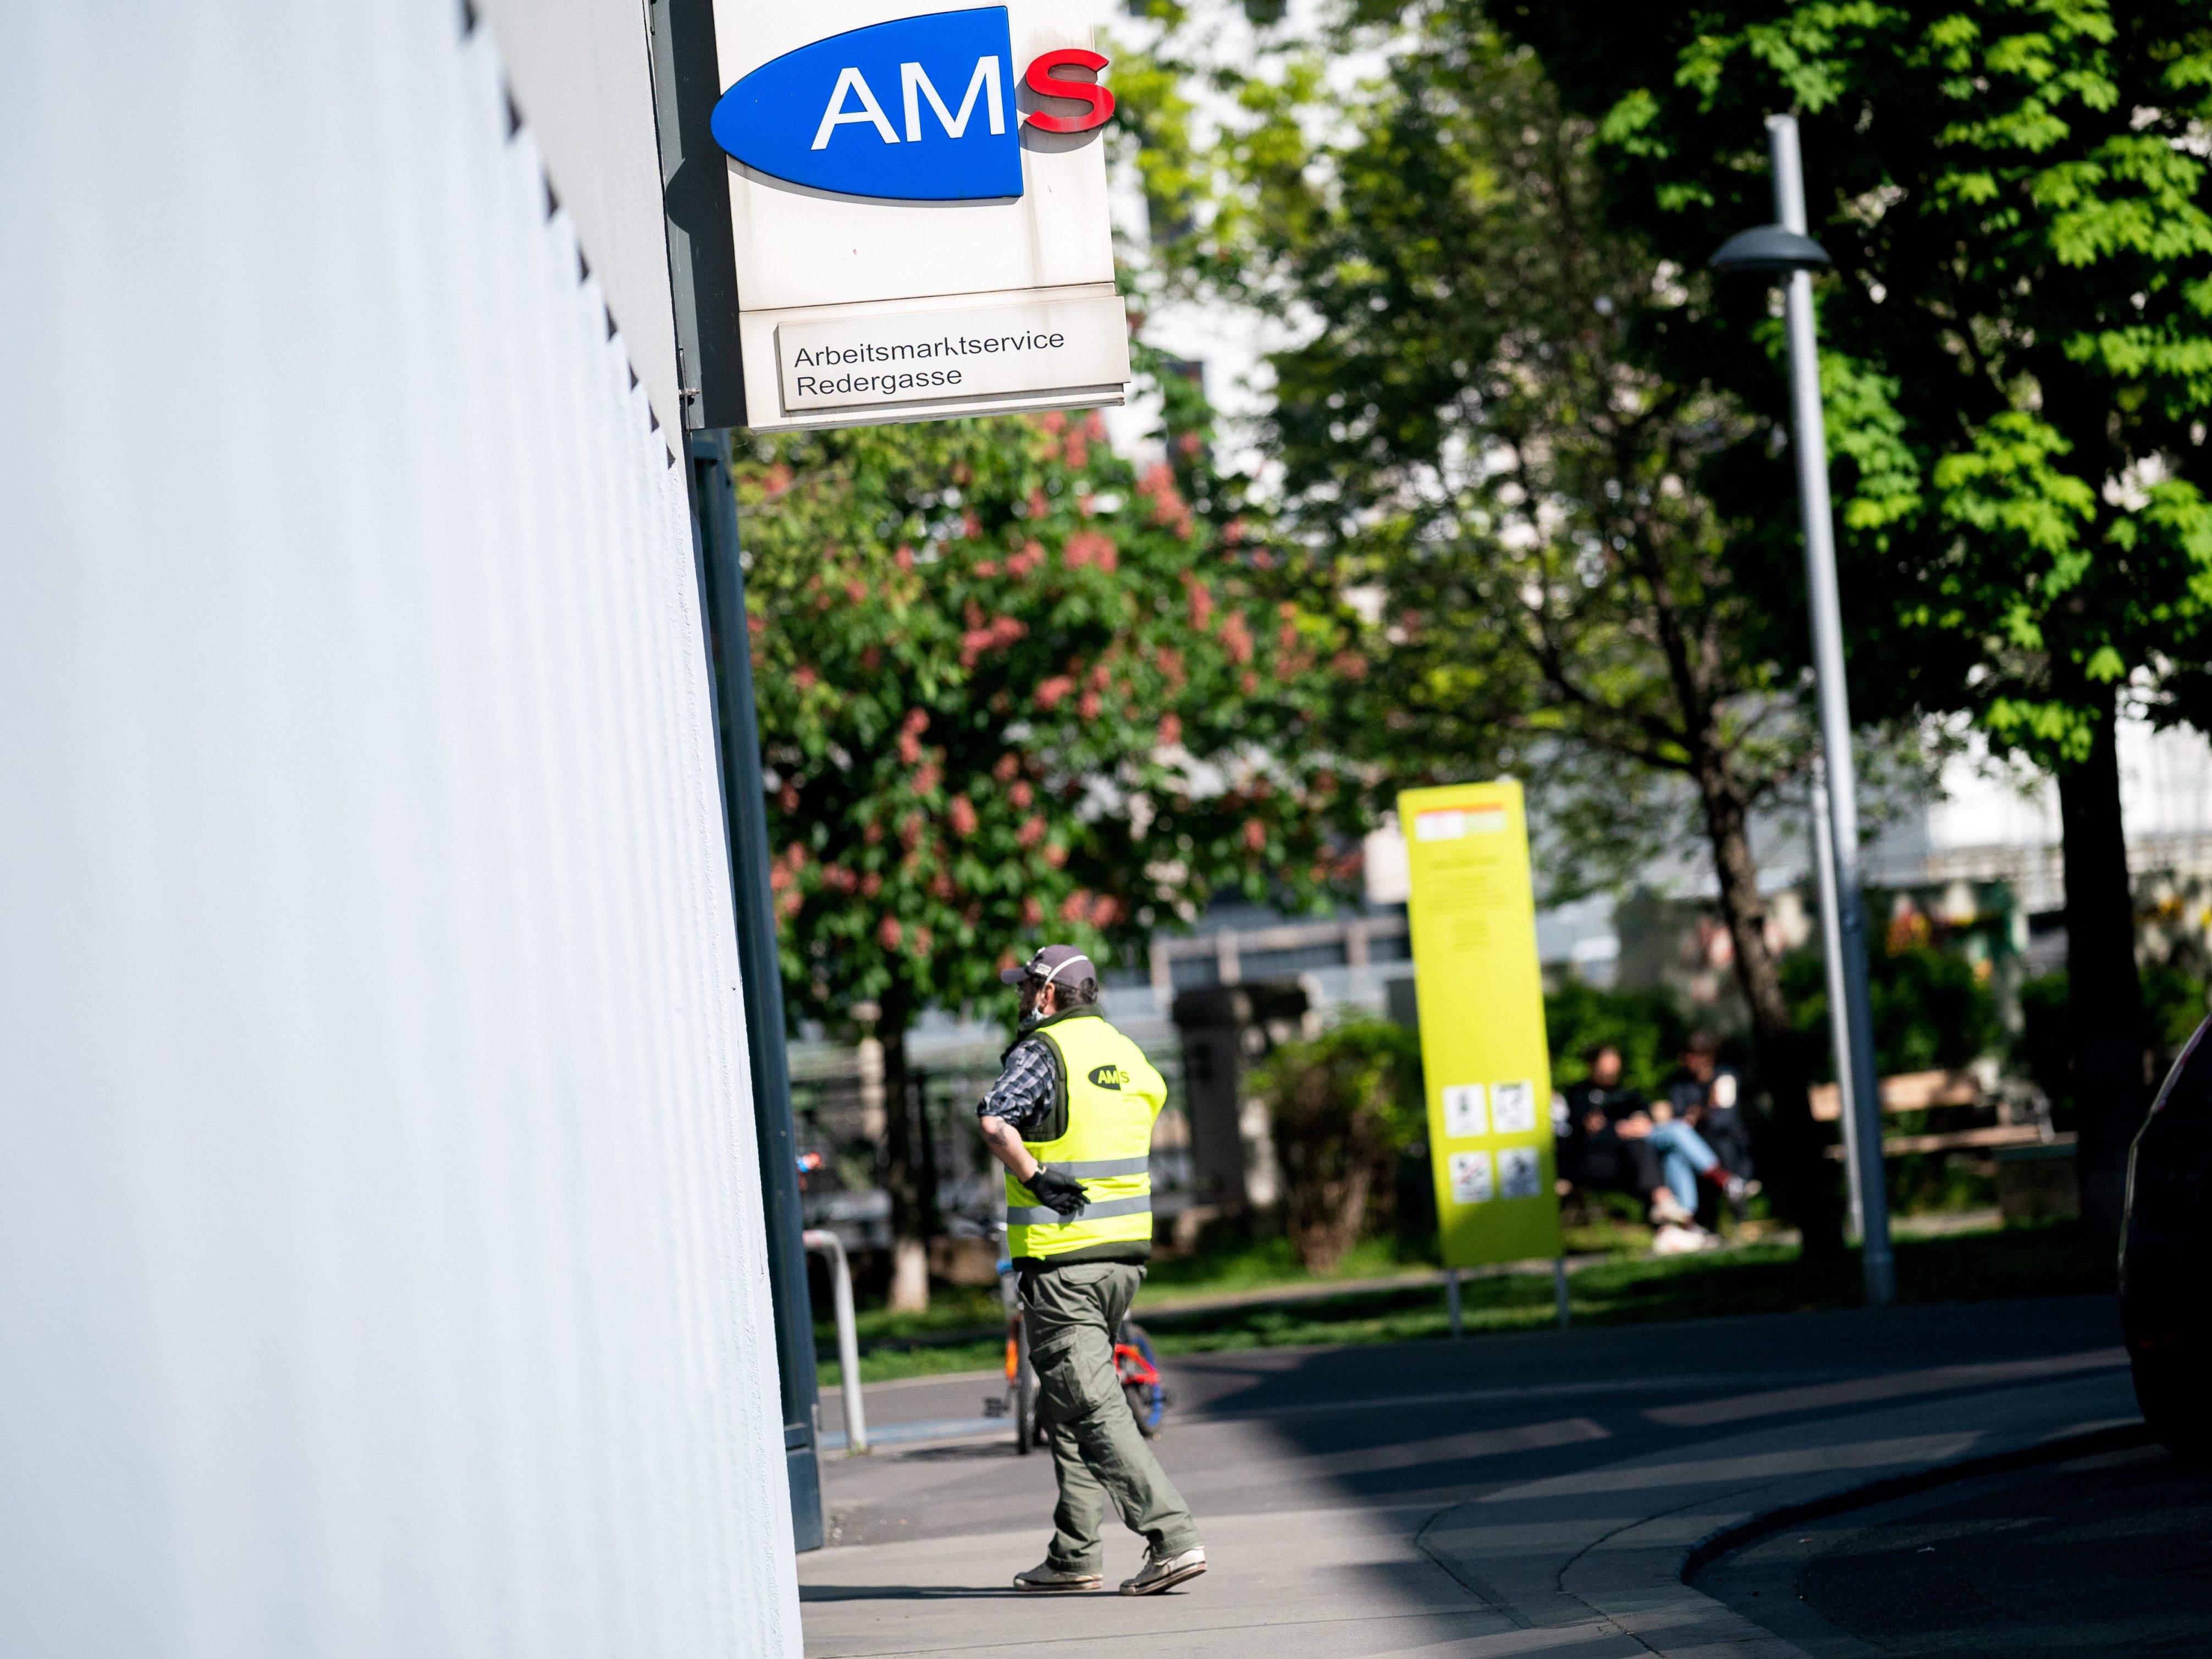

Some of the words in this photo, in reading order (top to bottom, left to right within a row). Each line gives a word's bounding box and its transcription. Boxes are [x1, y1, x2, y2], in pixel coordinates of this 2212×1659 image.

[810, 48, 1115, 150] AMS
[793, 330, 1065, 368] Arbeitsmarktservice
[797, 369, 962, 395] Redergasse
[1097, 1069, 1130, 1084] AMS
